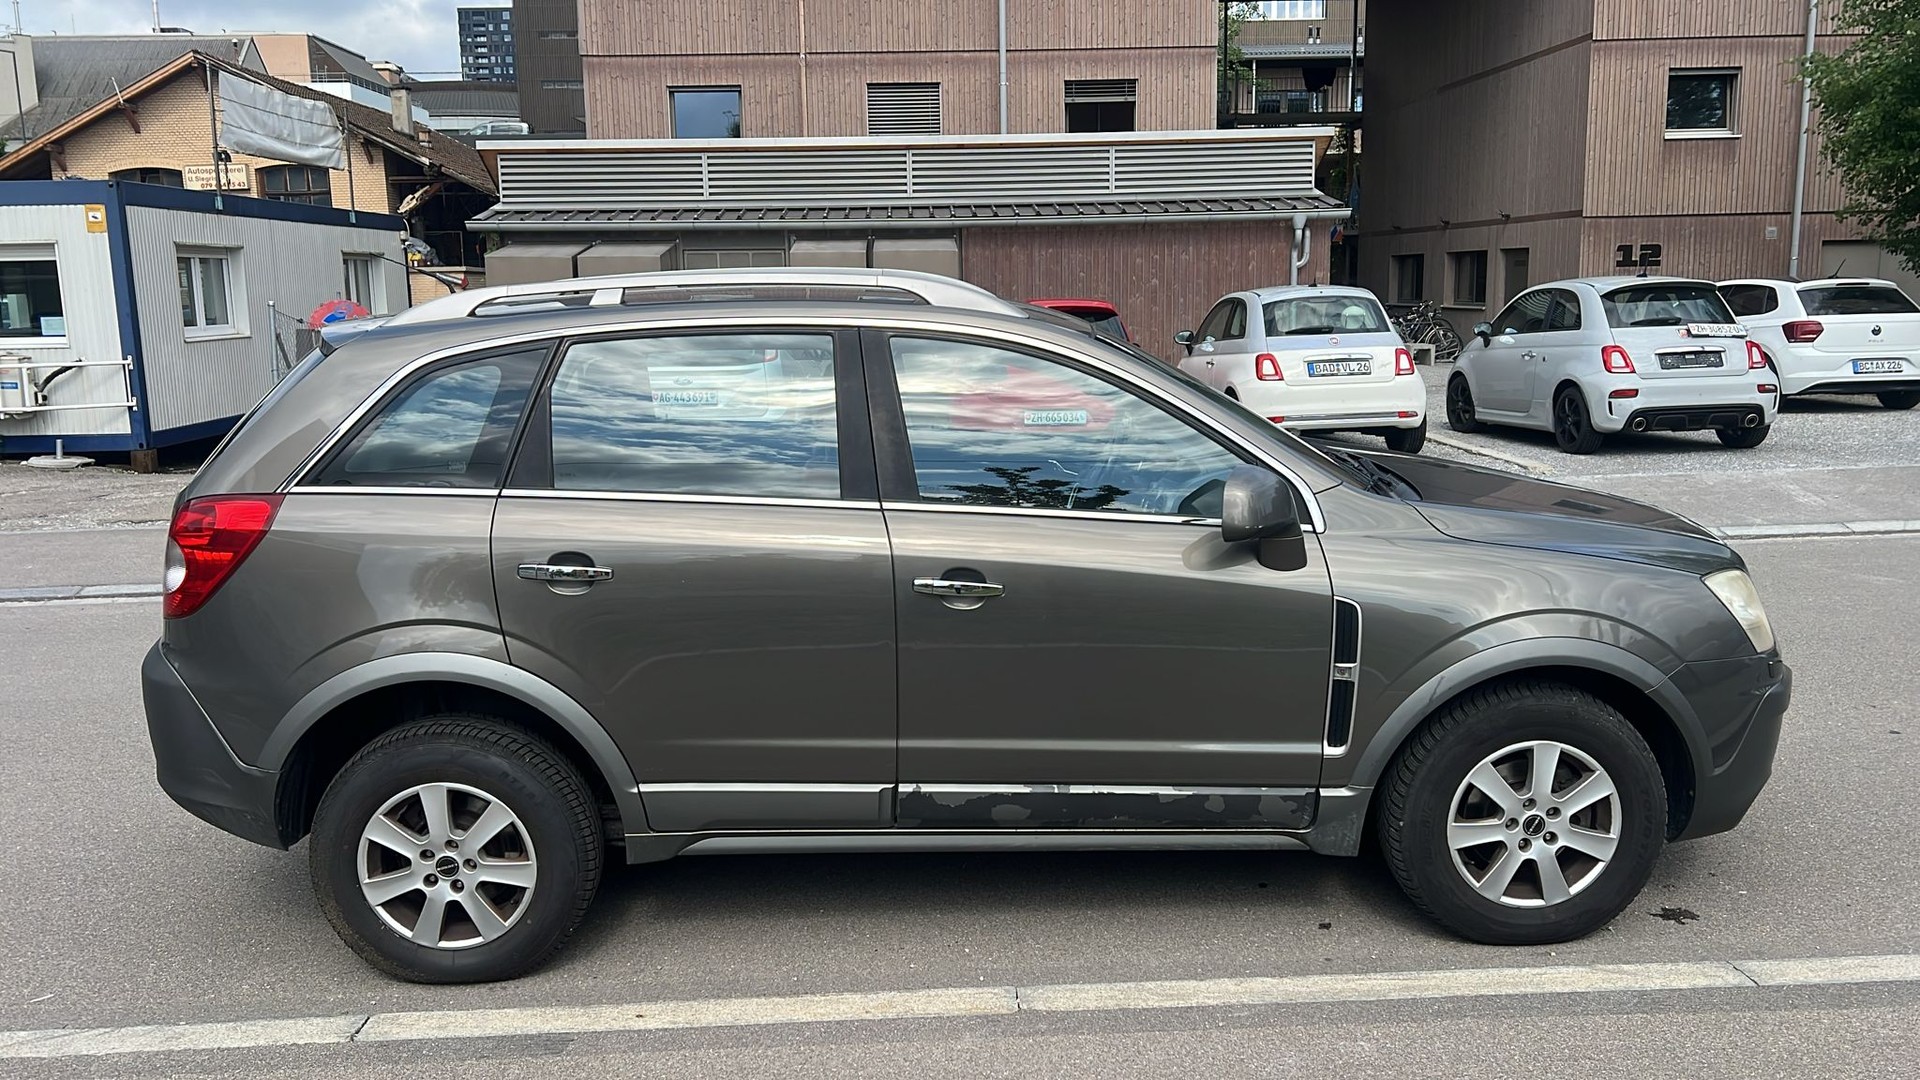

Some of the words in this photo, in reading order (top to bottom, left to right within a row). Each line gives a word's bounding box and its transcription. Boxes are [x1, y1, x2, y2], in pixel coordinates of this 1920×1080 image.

[187, 166, 244, 175] Autospgerei
[1616, 244, 1662, 267] 12
[1315, 363, 1335, 373] BAD
[1341, 363, 1355, 372] VL
[1356, 362, 1369, 371] 26
[1859, 362, 1870, 371] BC
[1875, 361, 1886, 370] AX
[1887, 361, 1902, 369] 226
